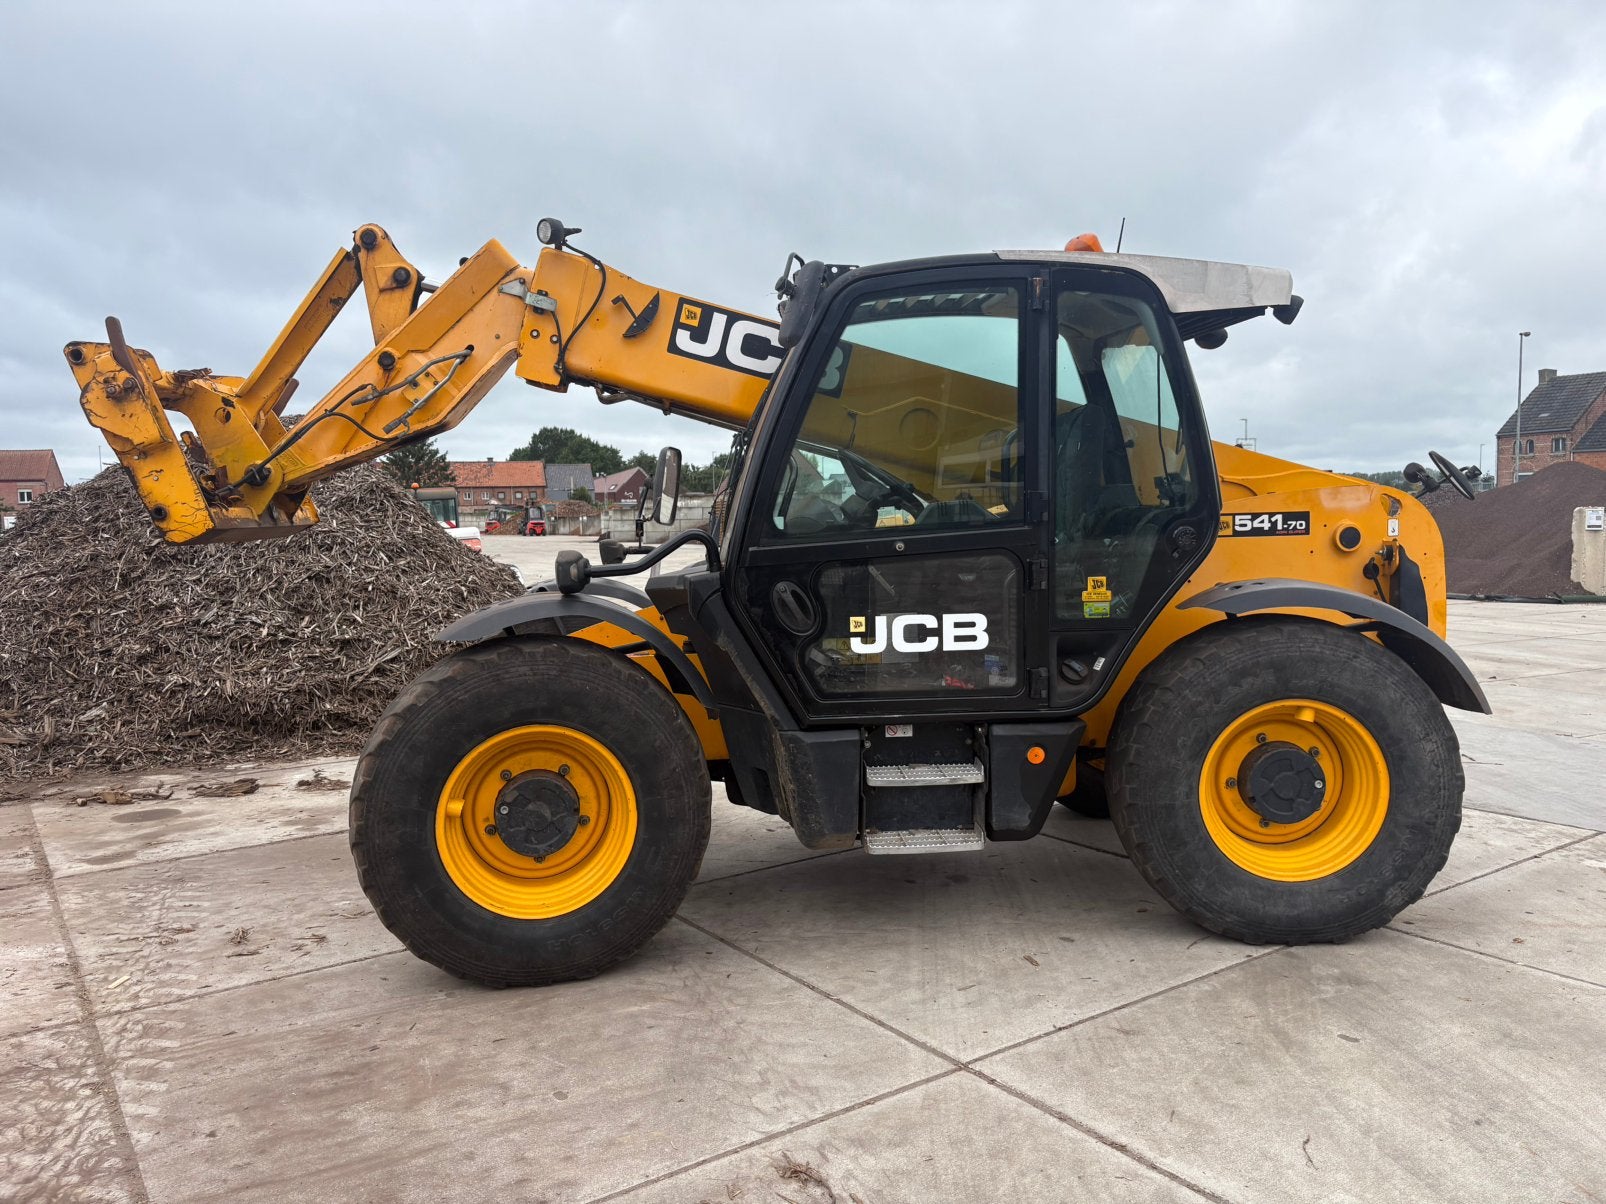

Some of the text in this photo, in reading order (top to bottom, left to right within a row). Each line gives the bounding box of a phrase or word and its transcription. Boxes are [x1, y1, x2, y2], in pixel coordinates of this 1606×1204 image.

[1234, 513, 1306, 532] 541-70
[1091, 579, 1105, 590] JCB
[850, 613, 990, 654] JCB
